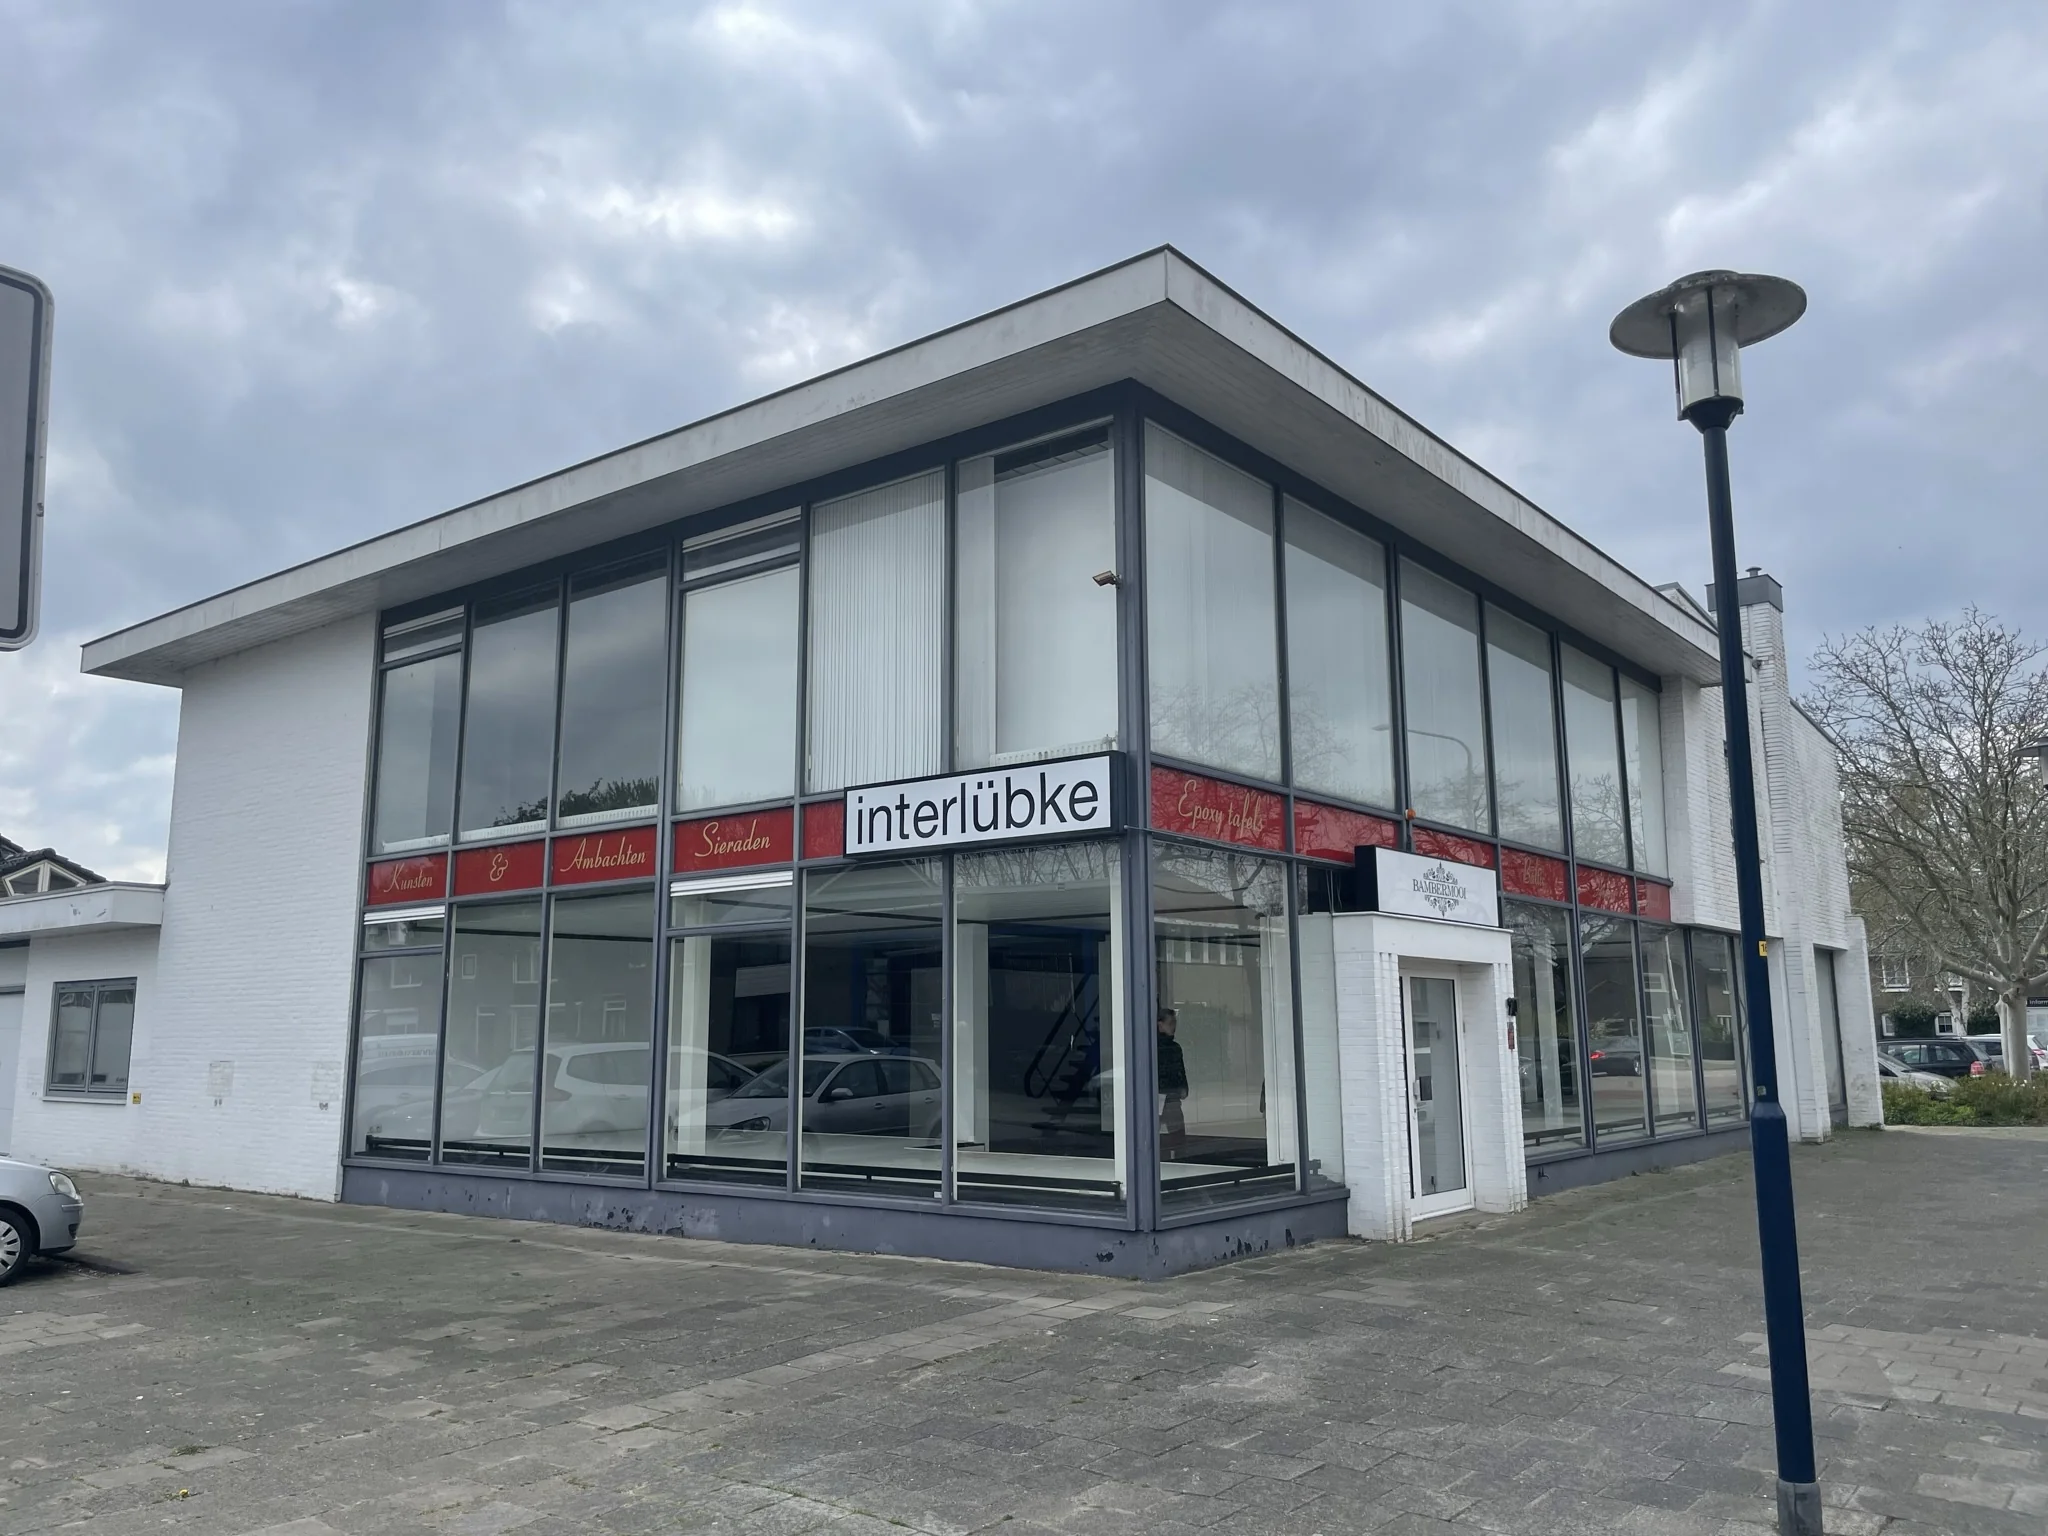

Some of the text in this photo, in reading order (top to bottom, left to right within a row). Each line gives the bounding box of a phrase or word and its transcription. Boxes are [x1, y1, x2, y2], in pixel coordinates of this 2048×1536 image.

[857, 772, 1099, 845] interlübke
[1178, 779, 1264, 838] Epoxy tafels
[384, 819, 770, 893] Kunsten & Ambachten Sieraden
[1412, 878, 1468, 900] BAMBERMOOI
